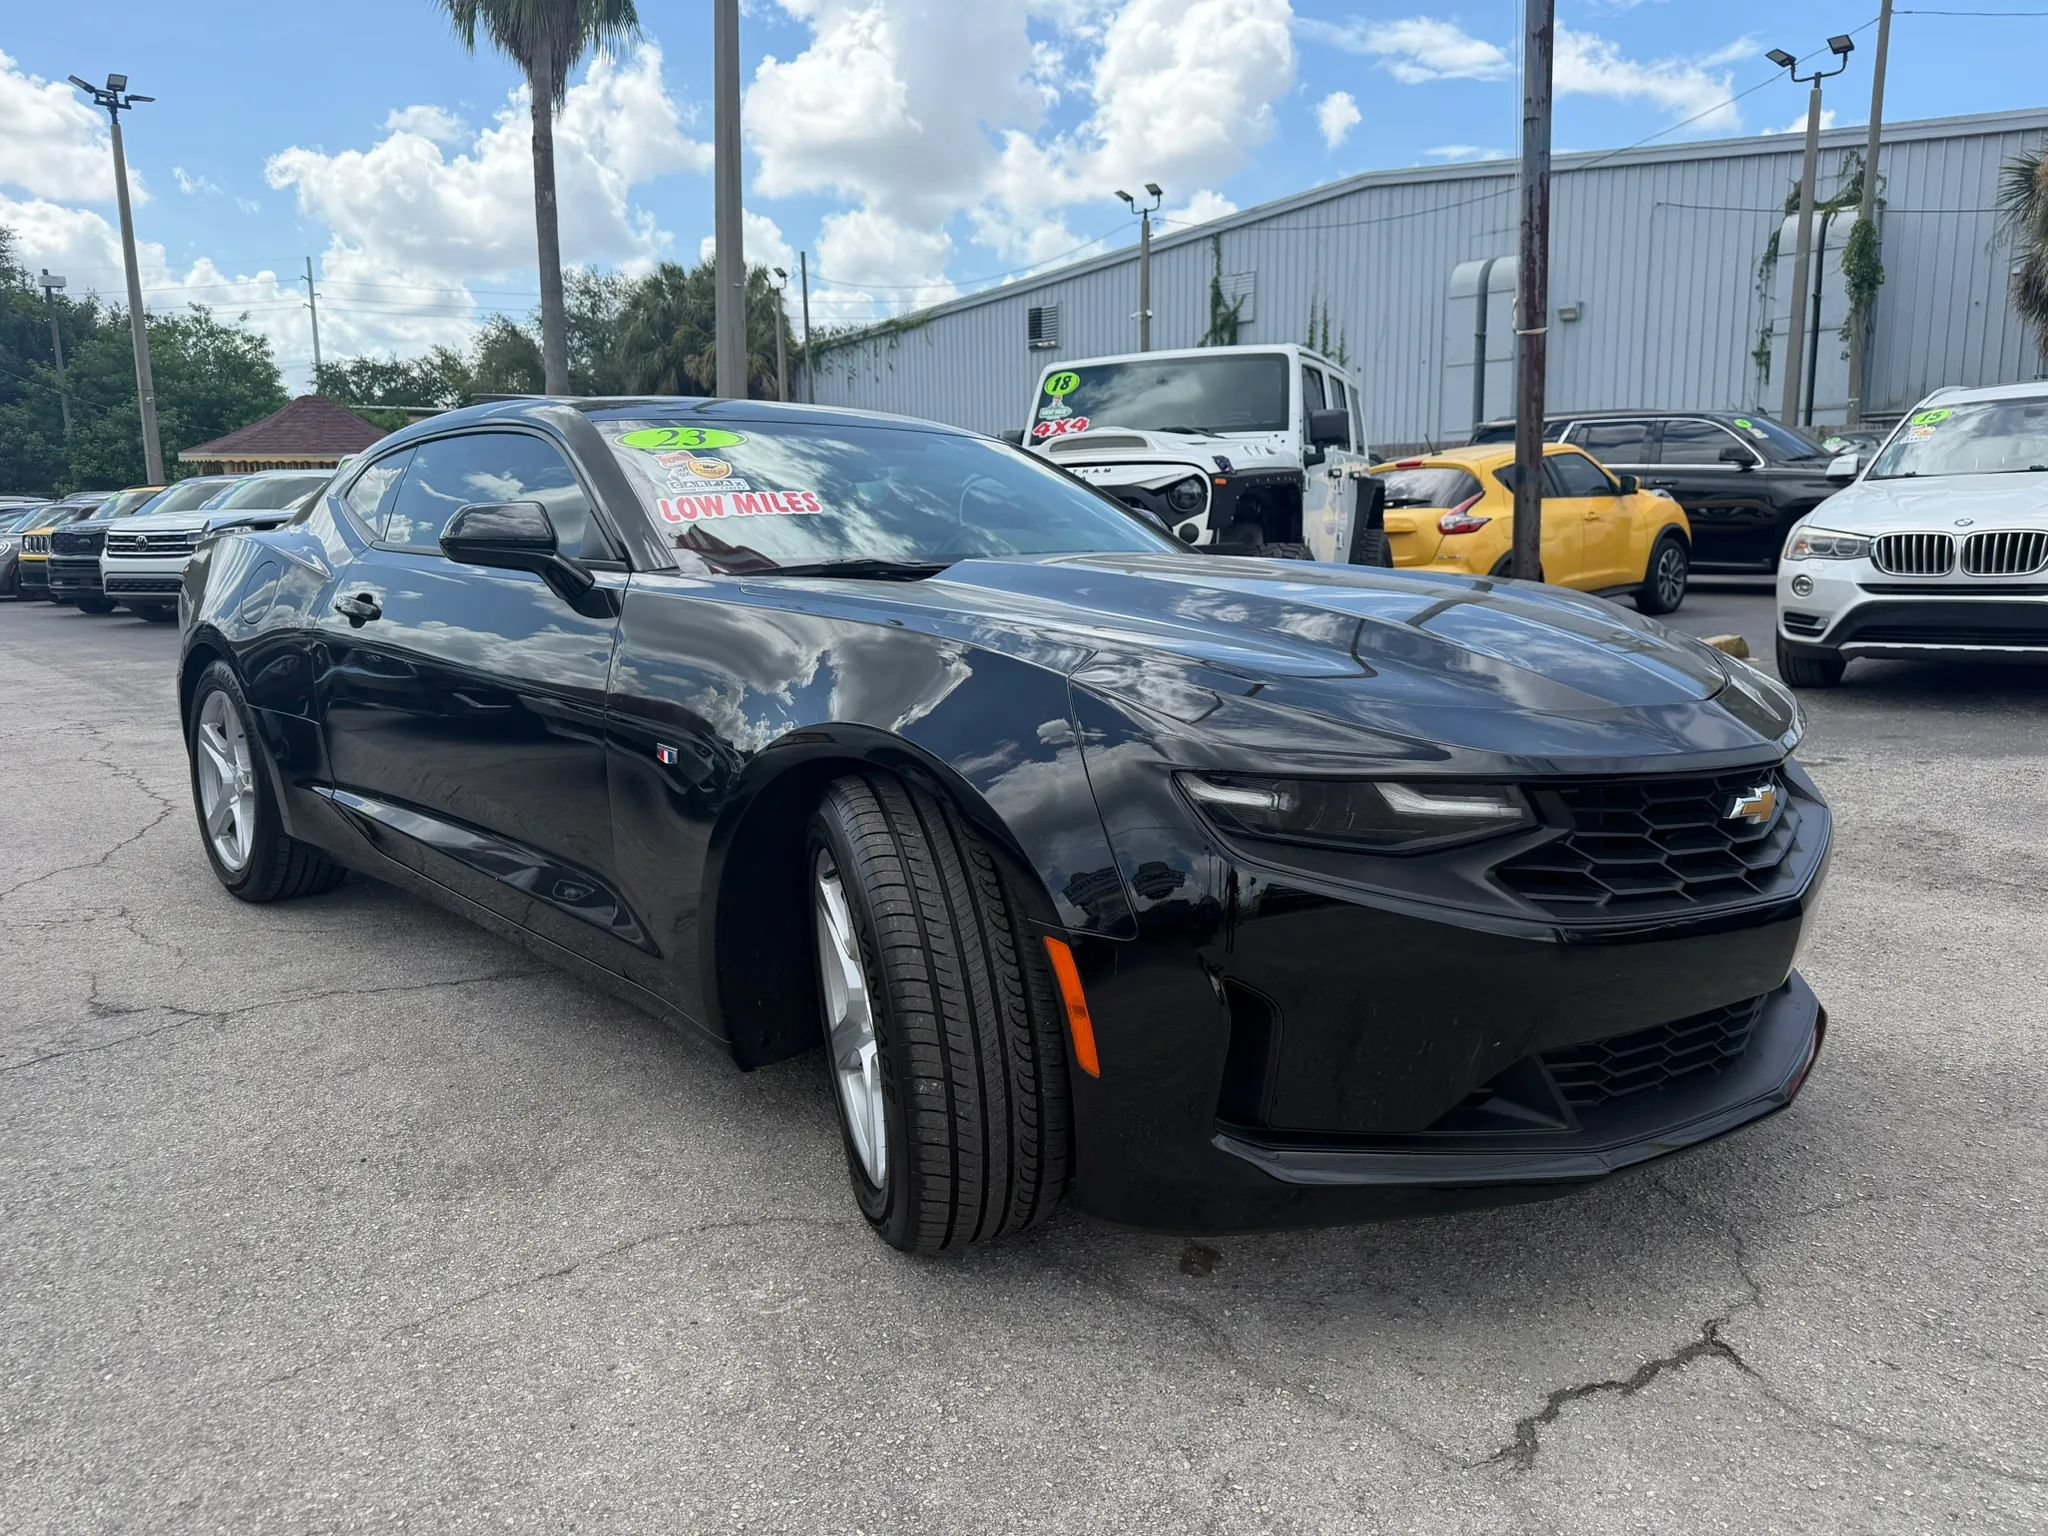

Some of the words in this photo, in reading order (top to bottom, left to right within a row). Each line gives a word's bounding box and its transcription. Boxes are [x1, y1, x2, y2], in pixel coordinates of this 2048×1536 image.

[1052, 375, 1072, 392] 18
[1919, 411, 1944, 423] 15
[1034, 418, 1089, 437] 4X4
[655, 429, 708, 447] 23
[670, 478, 745, 489] CARFAX
[661, 495, 724, 521] LOW
[732, 492, 820, 514] MILES
